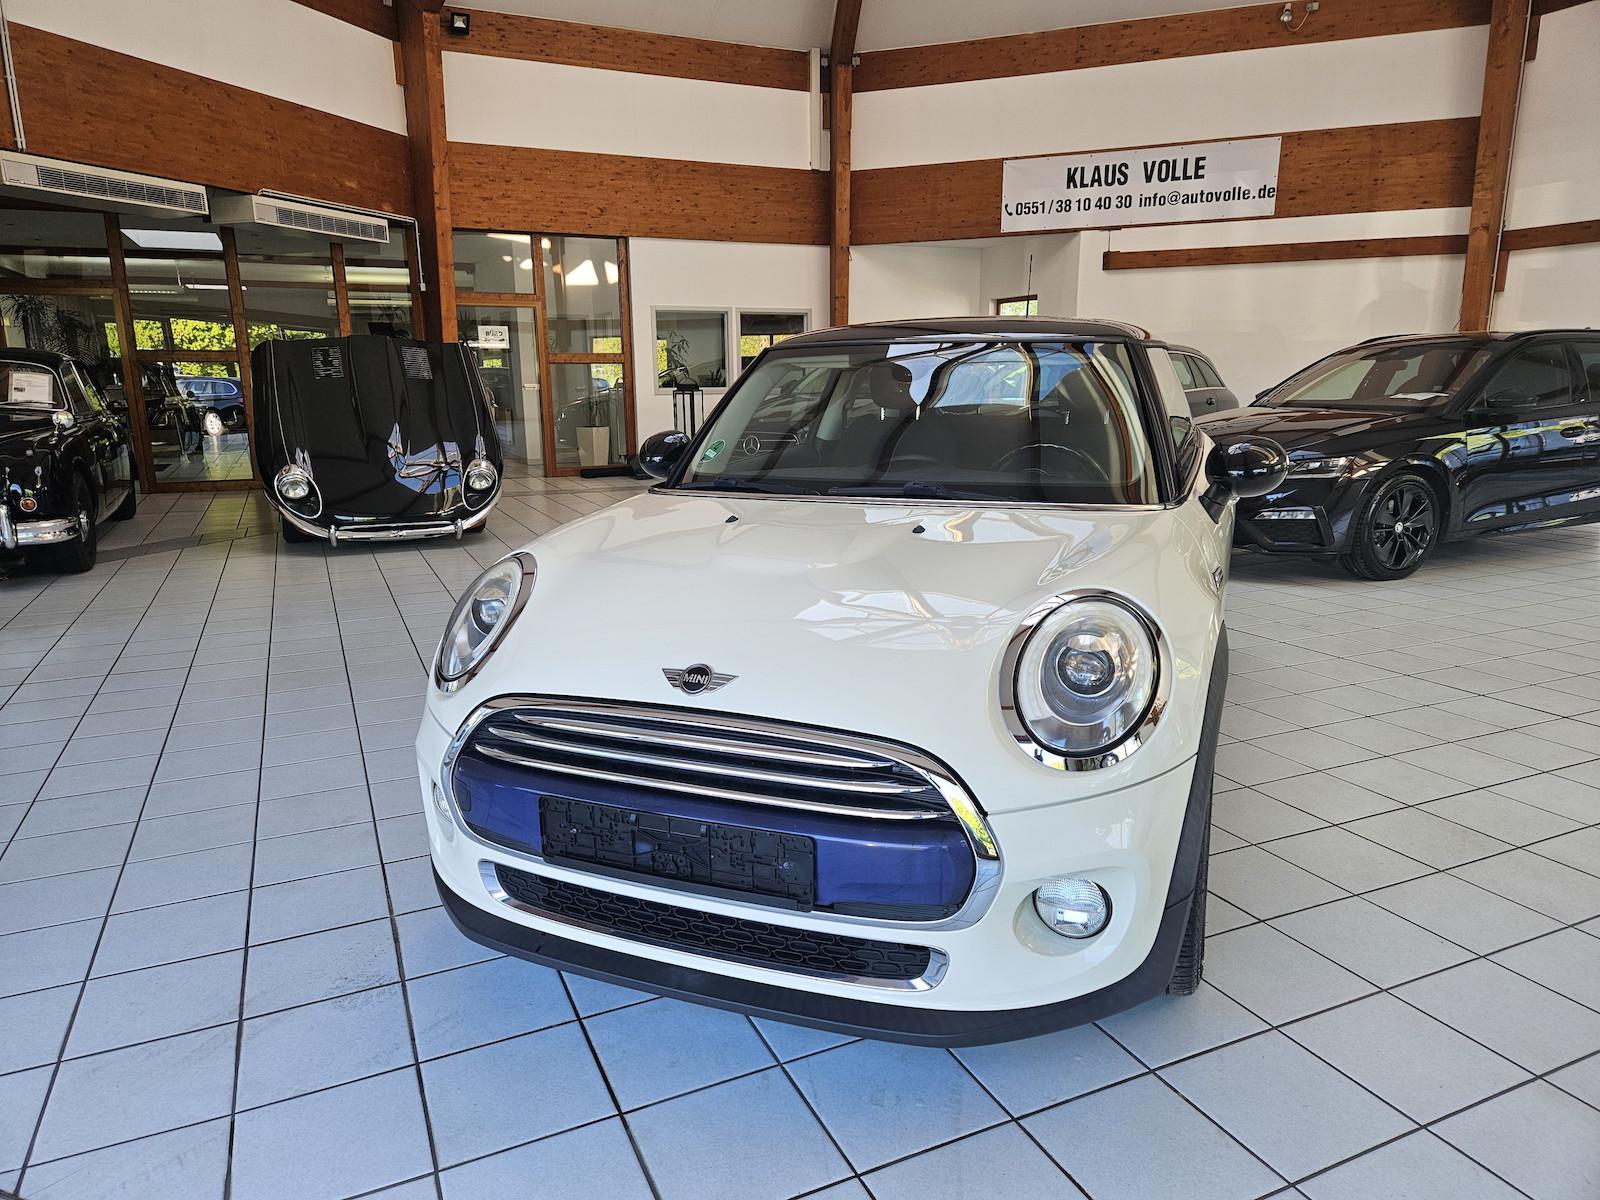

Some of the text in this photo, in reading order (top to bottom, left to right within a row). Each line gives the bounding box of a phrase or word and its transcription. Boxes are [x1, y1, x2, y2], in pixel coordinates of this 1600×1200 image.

[1066, 156, 1207, 189] KLAUS VOLLE
[1076, 198, 1091, 212] 10
[1094, 196, 1112, 211] 40
[1115, 195, 1133, 209] 30
[1139, 184, 1276, 207] info@autovolle.de
[683, 674, 708, 684] MINI
